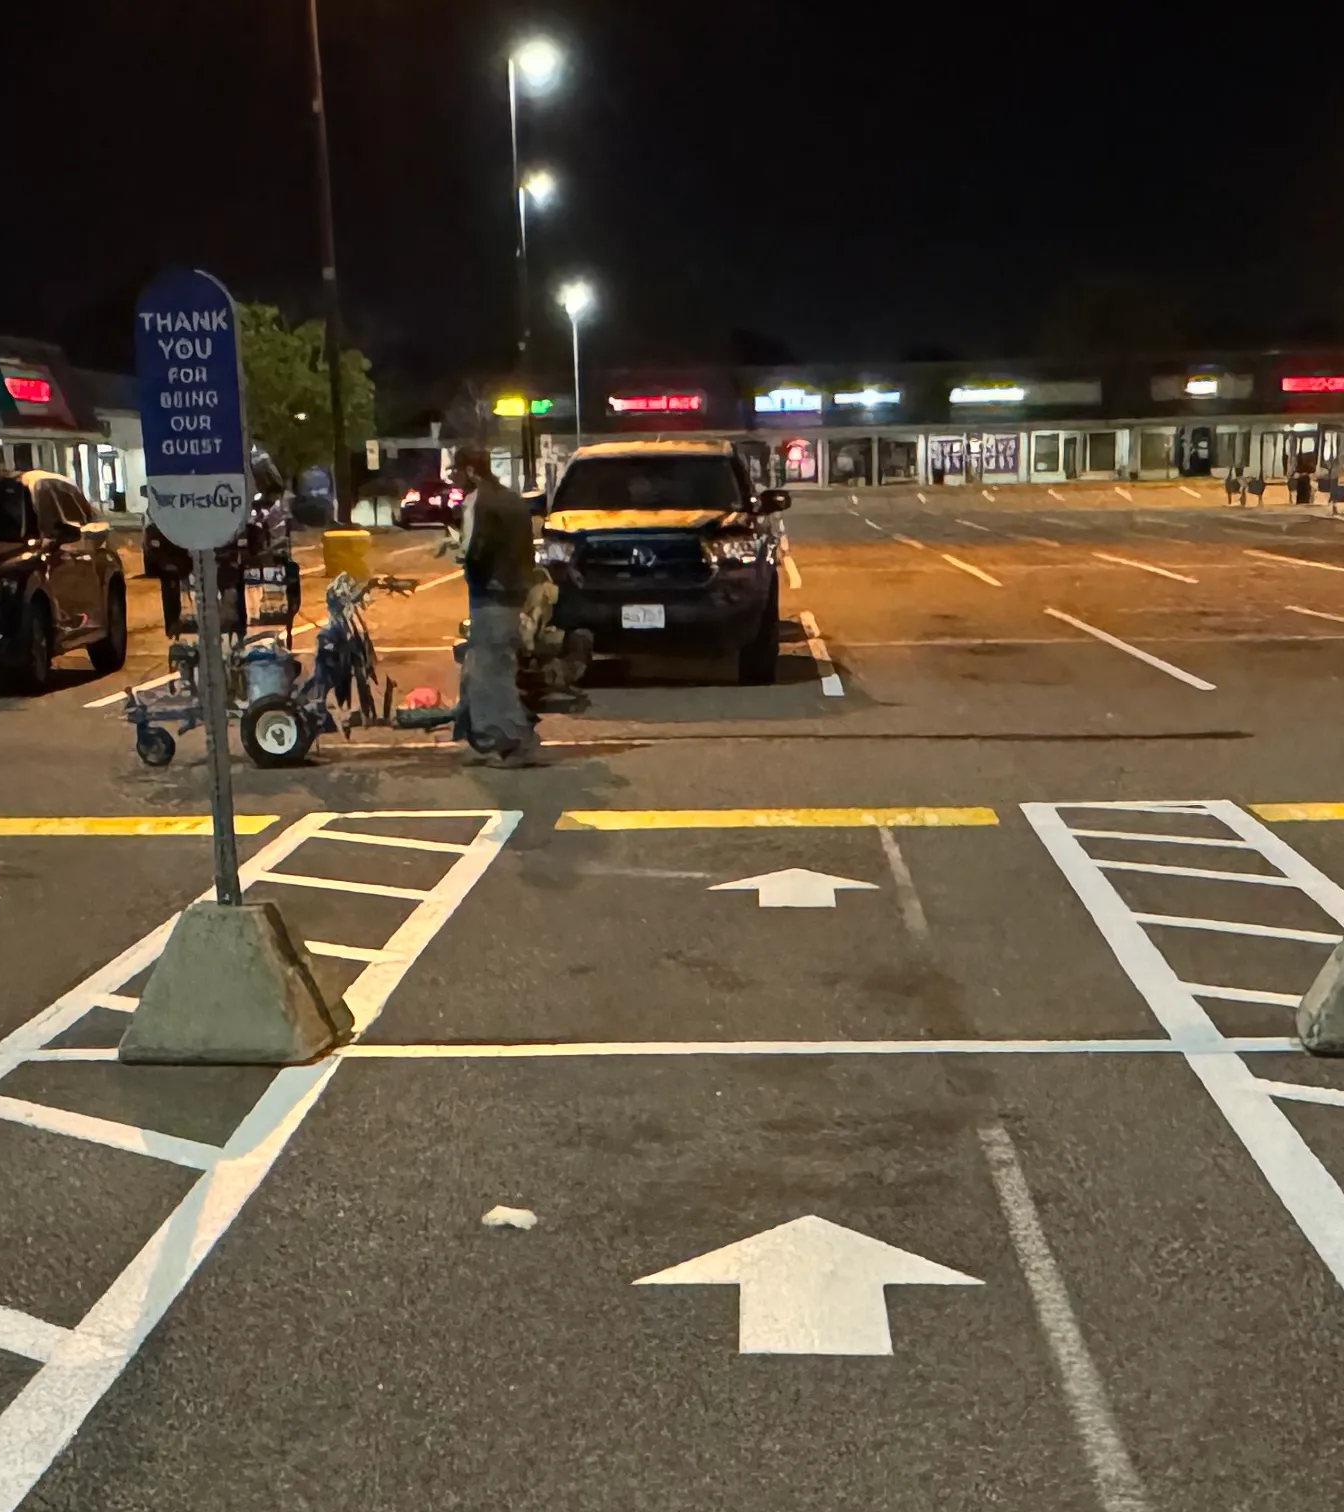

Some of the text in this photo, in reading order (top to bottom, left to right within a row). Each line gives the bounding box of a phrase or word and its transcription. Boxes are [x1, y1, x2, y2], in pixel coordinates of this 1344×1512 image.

[139, 309, 228, 333] THANK
[158, 337, 212, 360] YOU
[168, 366, 207, 384] FOR
[160, 391, 219, 408] BEING
[170, 415, 211, 432] OUR
[162, 438, 222, 455] GUEST
